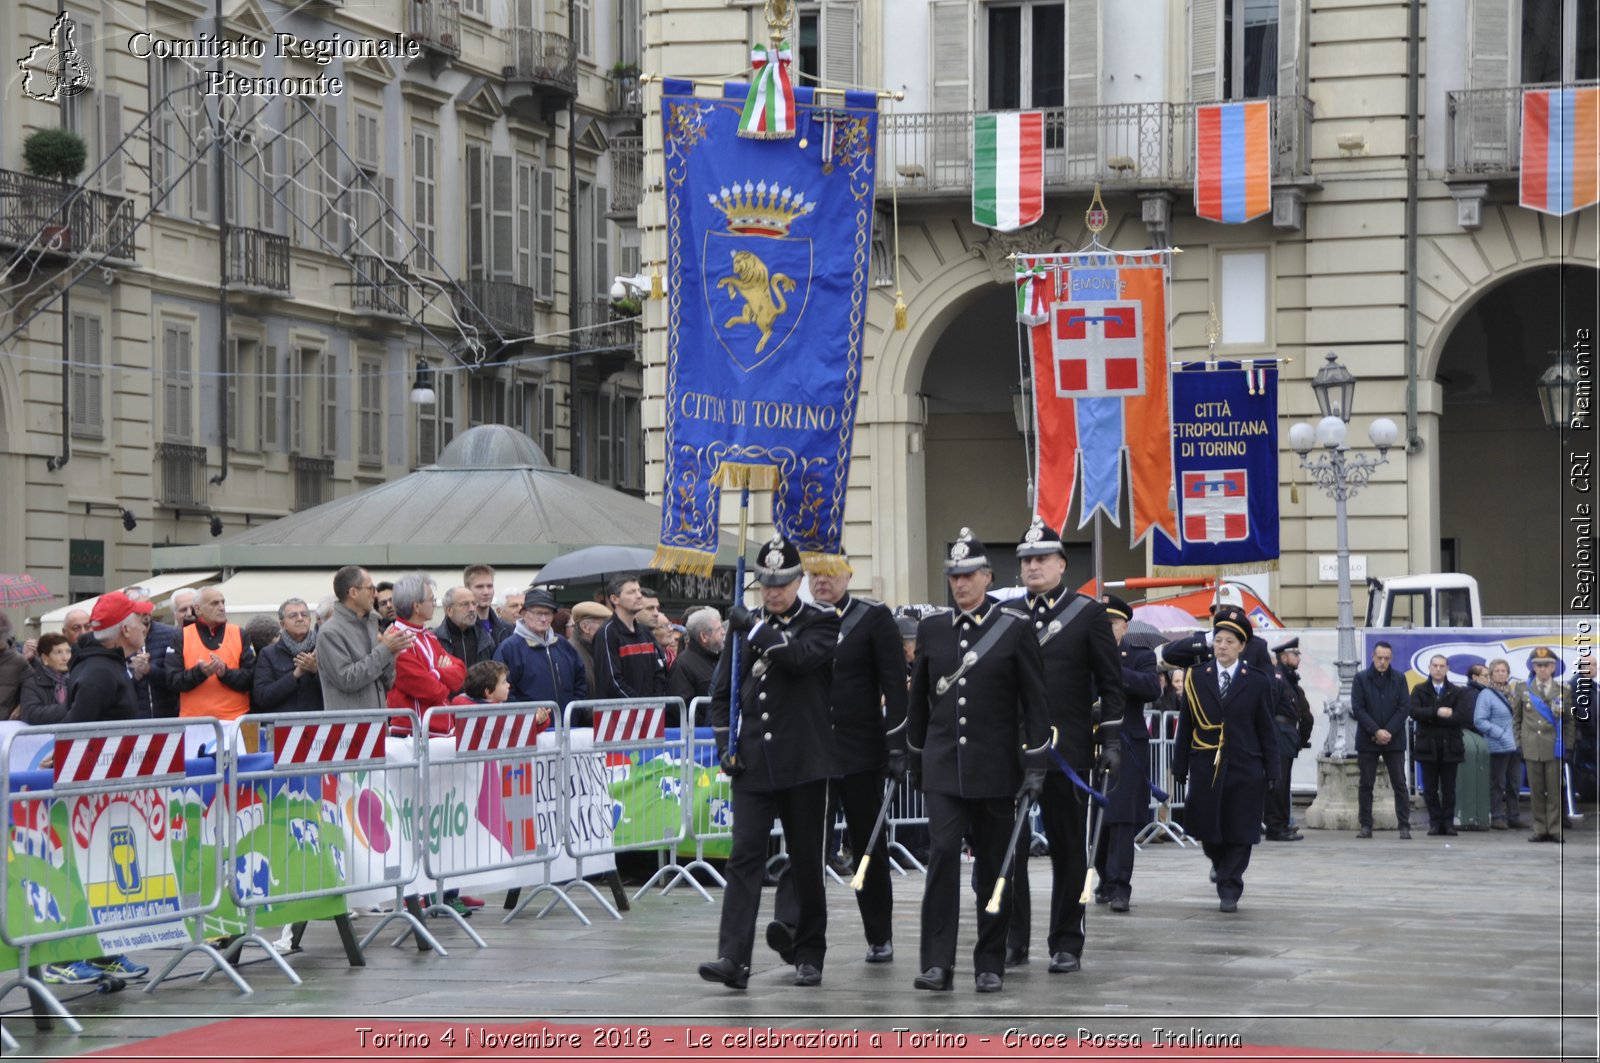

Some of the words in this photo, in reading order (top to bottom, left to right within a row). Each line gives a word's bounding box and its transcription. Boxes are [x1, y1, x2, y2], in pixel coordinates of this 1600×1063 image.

[732, 400, 747, 426] DI
[752, 401, 836, 431] TORINO
[1194, 400, 1232, 418] CITTÀ
[1172, 420, 1269, 438] ETROPOLITANA
[1181, 442, 1195, 457] DI
[1198, 441, 1247, 457] TORINO
[101, 937, 112, 949] Per
[113, 936, 124, 948] noi
[123, 935, 131, 946] la
